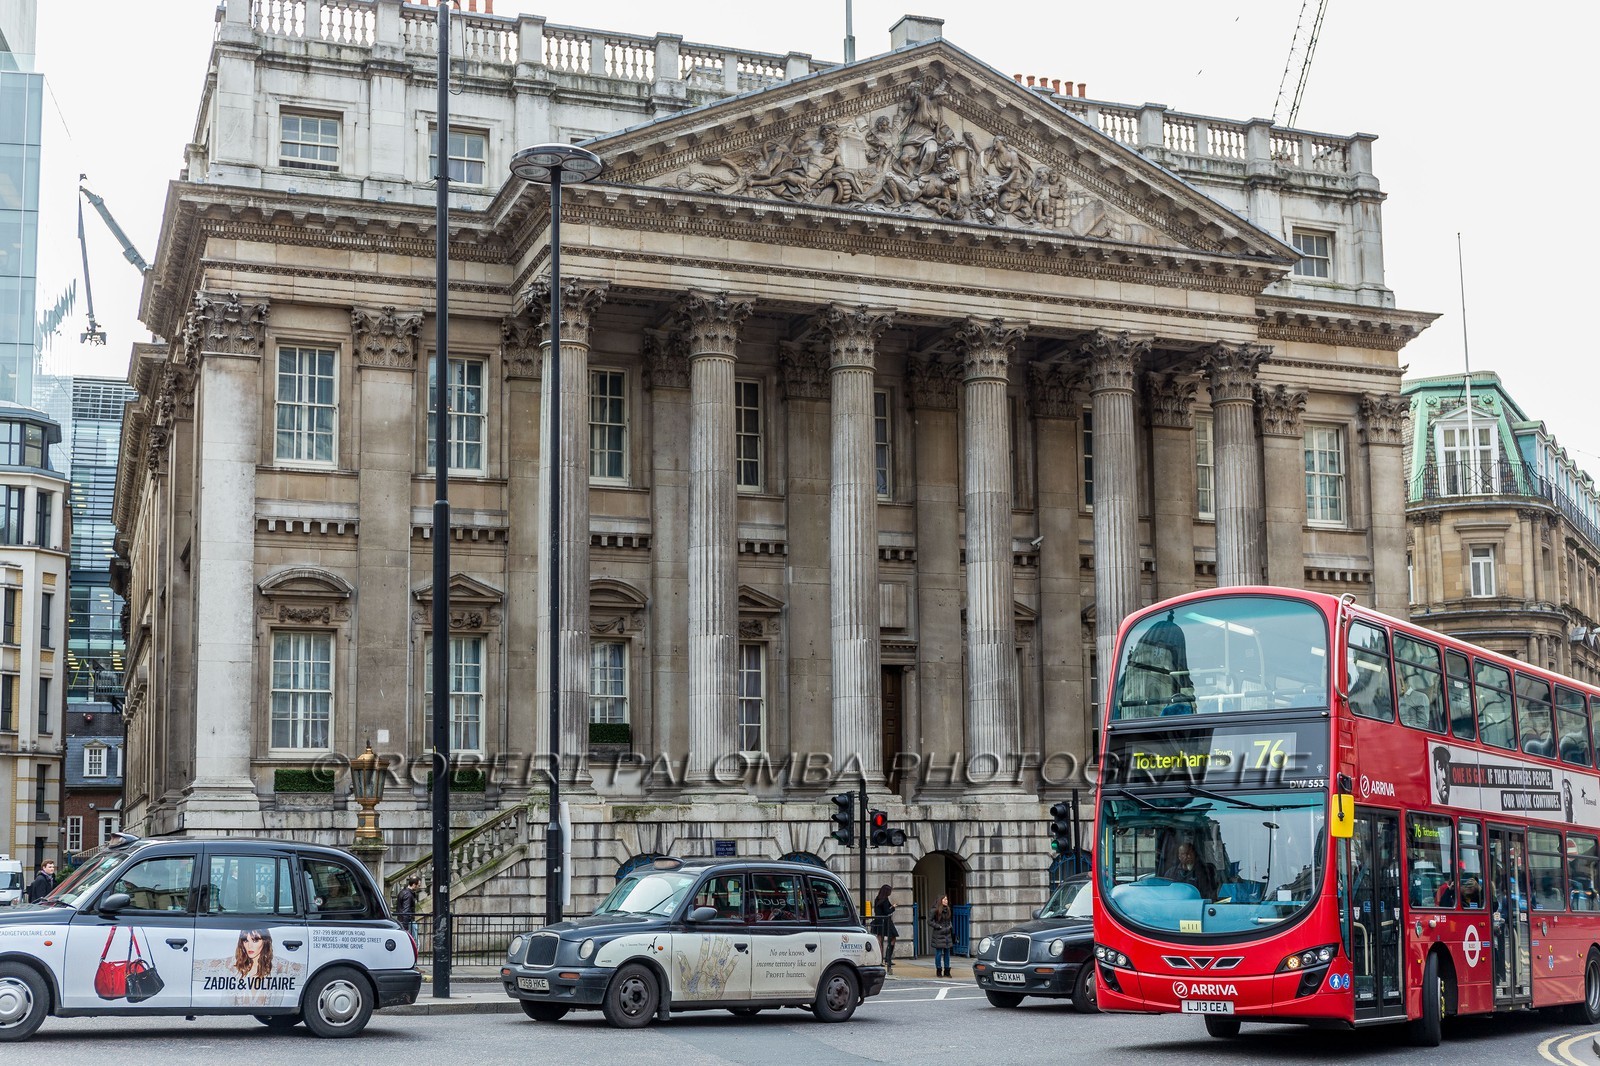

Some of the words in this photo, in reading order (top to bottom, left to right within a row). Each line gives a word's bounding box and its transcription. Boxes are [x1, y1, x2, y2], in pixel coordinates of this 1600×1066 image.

[1214, 748, 1232, 756] Town
[1254, 739, 1288, 769] 76
[1133, 750, 1211, 770] Tottenham
[1452, 767, 1464, 784] ONE
[1465, 767, 1471, 784] IS
[1473, 767, 1487, 784] GAY.
[1487, 768, 1493, 785] IF
[1494, 768, 1508, 785] THAT
[1509, 769, 1531, 786] BOTHERS
[1532, 769, 1552, 788] PEOPLE,
[1290, 779, 1306, 789] DW
[1308, 779, 1324, 788] 553
[1370, 780, 1395, 797] ARRIVA
[1503, 793, 1515, 808] OUR
[1515, 793, 1532, 809] WORK
[1533, 794, 1560, 809] CONTINUES.
[1413, 823, 1421, 838] 76
[787, 948, 805, 956] knows
[775, 960, 796, 969] territory
[786, 970, 807, 978] hunters.
[1008, 973, 1021, 981] KAH
[533, 980, 546, 988] HKE
[1190, 983, 1238, 996] ARRIVA
[1187, 1001, 1208, 1012] LJ13
[1210, 1002, 1228, 1012] CEA
